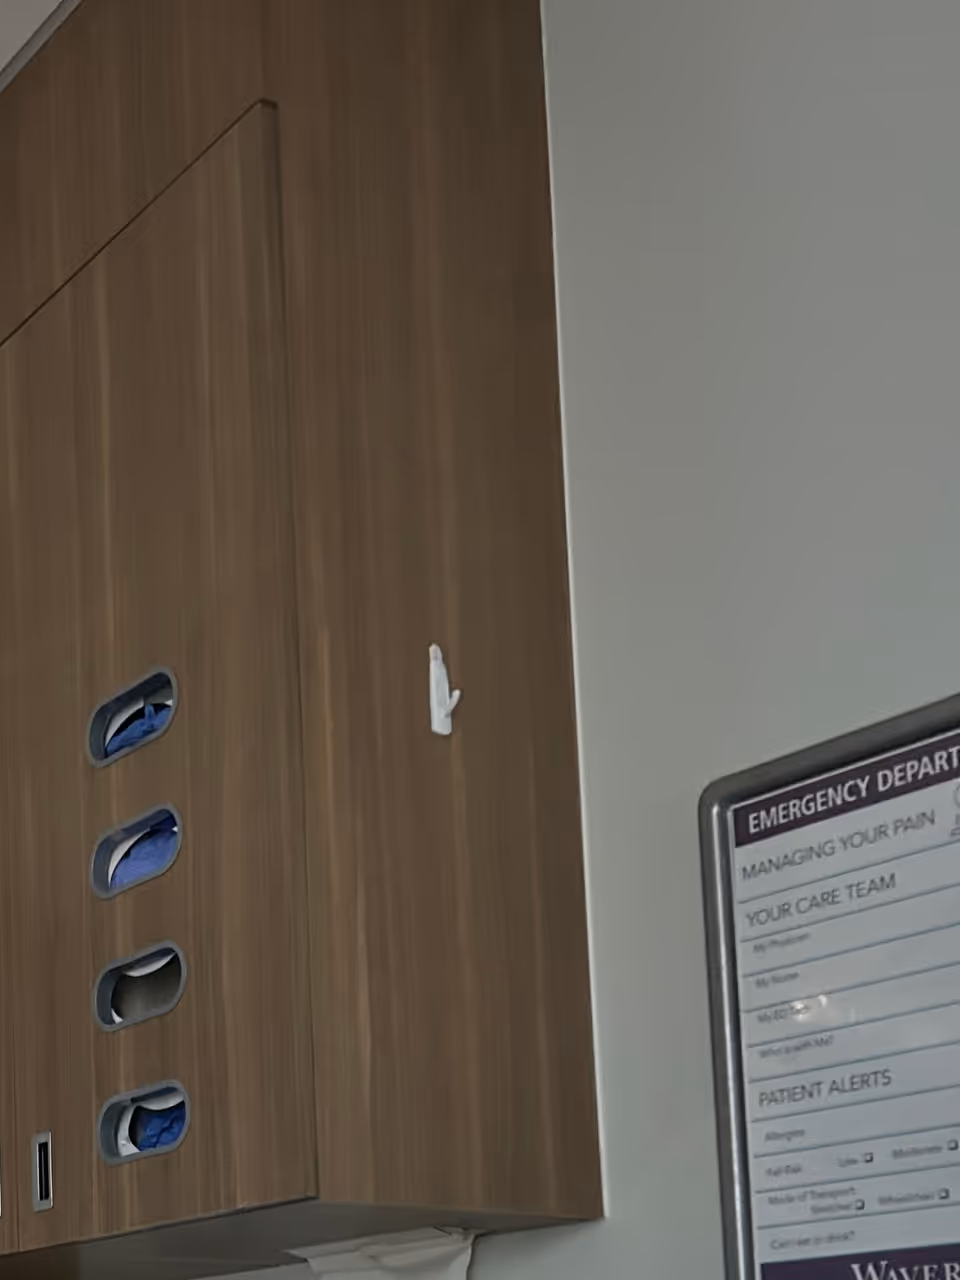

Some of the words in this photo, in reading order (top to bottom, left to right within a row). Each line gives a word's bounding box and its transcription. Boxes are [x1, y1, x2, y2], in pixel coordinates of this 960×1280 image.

[748, 775, 870, 834] EMERGENCY
[741, 838, 836, 880] MANAGING
[839, 823, 889, 851] YOUR
[892, 809, 936, 836] PAIN
[745, 903, 794, 928] YOUR
[795, 888, 842, 914] CARE
[844, 872, 896, 899] TEAM
[758, 1083, 825, 1108] PATIENT
[827, 1069, 892, 1096] ALERTS
